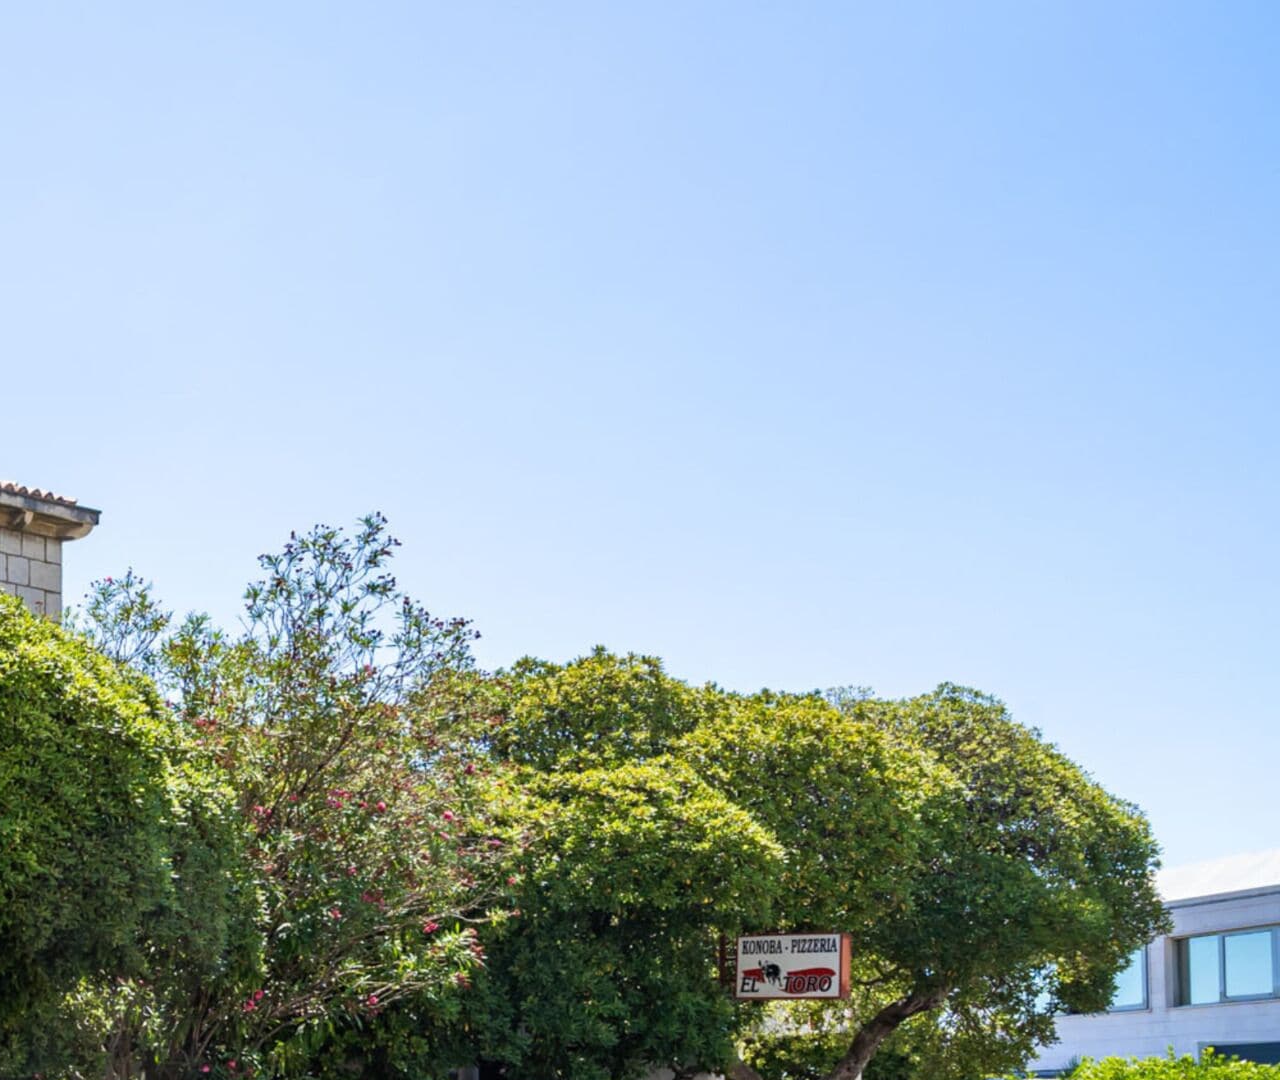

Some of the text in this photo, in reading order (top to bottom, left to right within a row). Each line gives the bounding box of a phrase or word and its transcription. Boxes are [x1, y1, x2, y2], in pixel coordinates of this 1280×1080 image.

[742, 940, 782, 954] KONOBA
[791, 938, 837, 953] PIZZERIA
[741, 975, 832, 992] EL TORO
